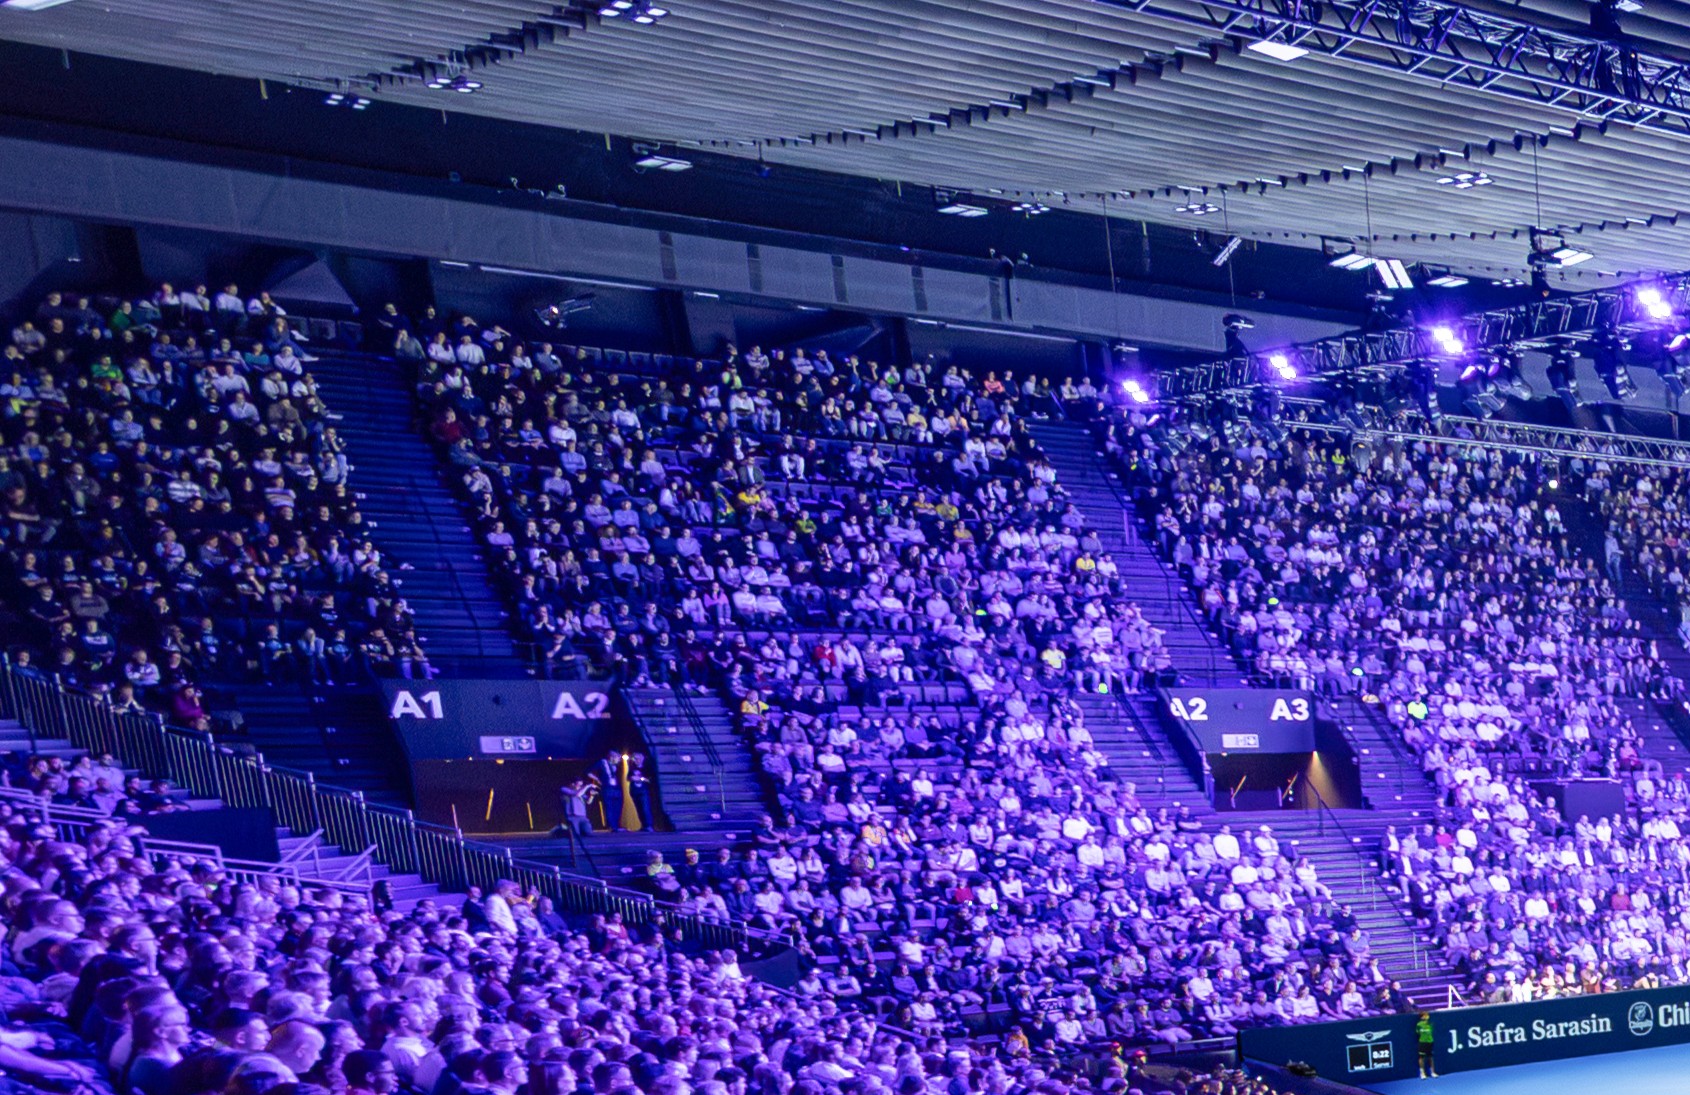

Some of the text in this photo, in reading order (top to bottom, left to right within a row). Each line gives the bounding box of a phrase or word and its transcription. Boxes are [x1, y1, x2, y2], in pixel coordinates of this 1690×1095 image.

[391, 690, 444, 719] A1
[552, 692, 610, 720] A2
[1270, 698, 1310, 721] A3
[1448, 1014, 1612, 1054] J. Safra Sarasin
